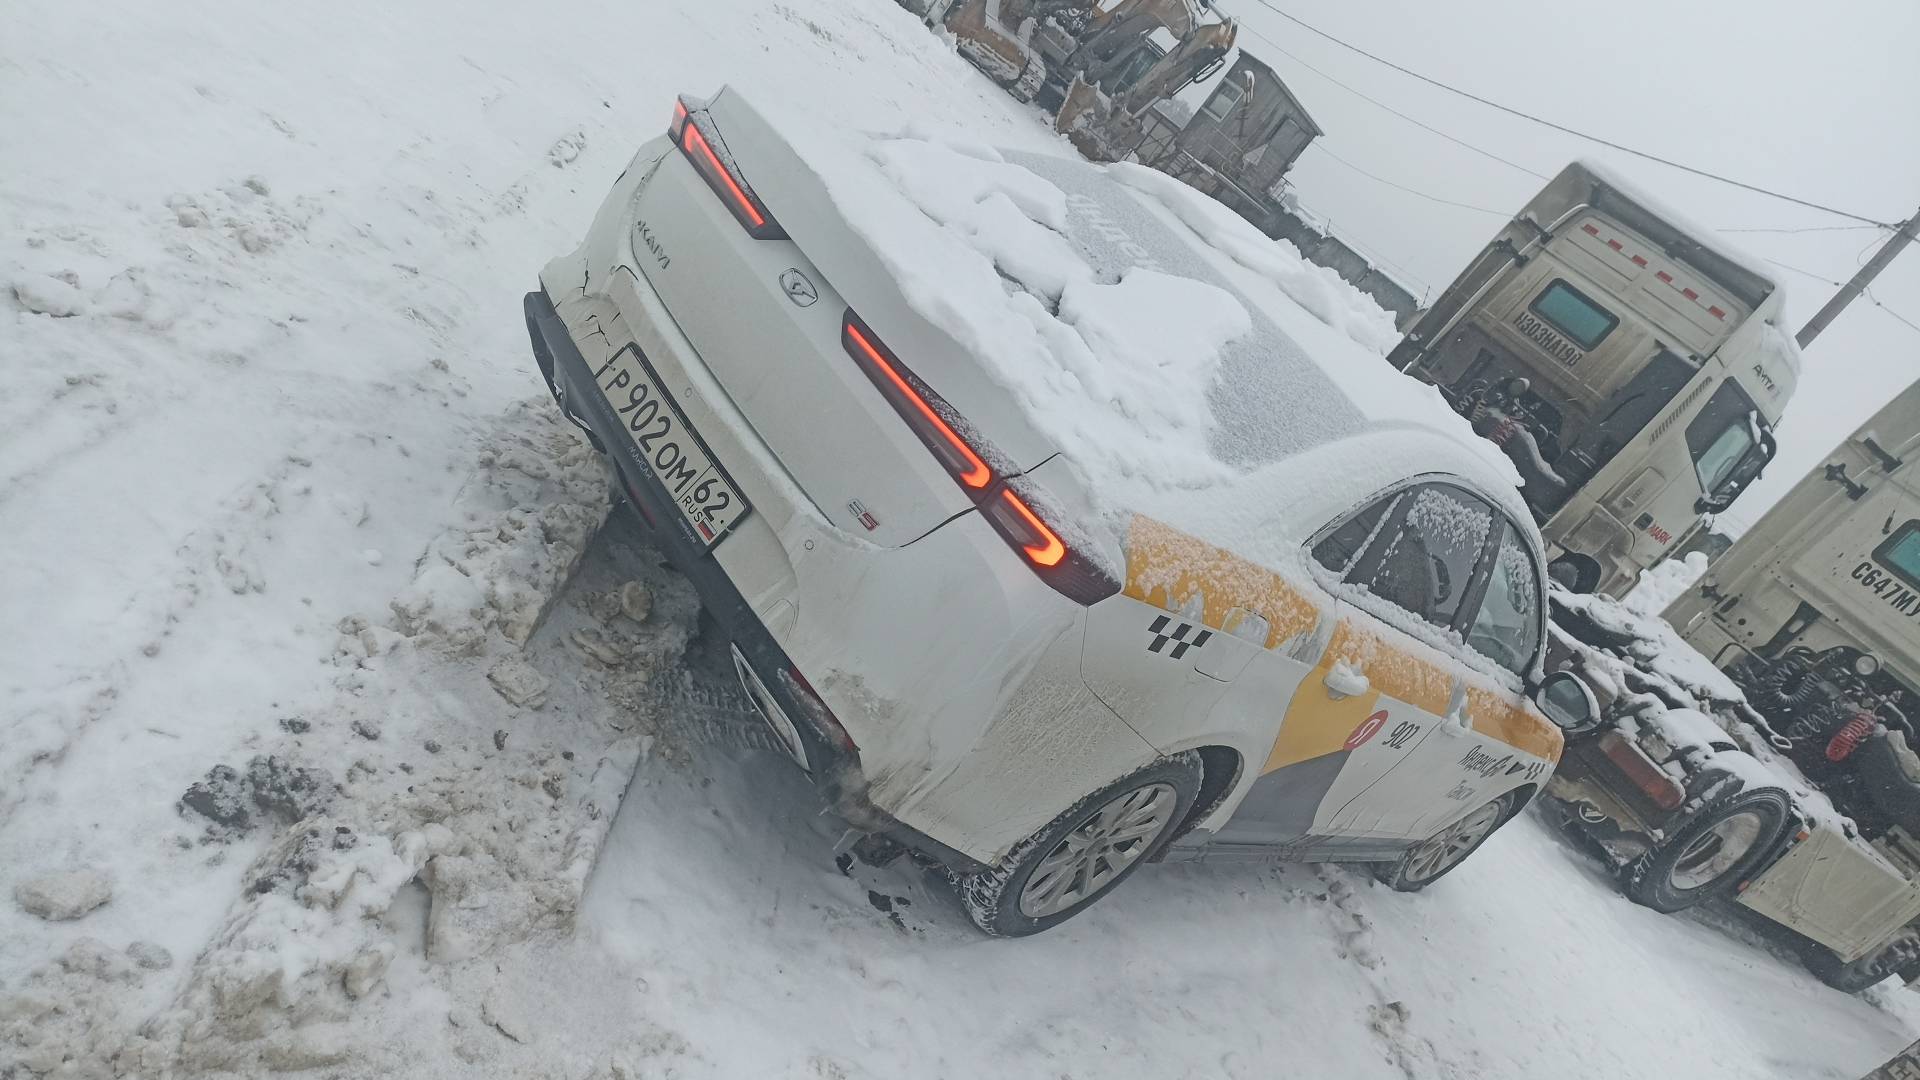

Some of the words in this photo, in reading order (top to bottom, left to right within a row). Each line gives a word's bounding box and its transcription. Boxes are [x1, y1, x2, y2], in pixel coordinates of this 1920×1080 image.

[605, 368, 697, 494] Р902ОМ
[694, 478, 730, 522] 62
[681, 495, 704, 523] RUS
[1382, 721, 1420, 749] 902
